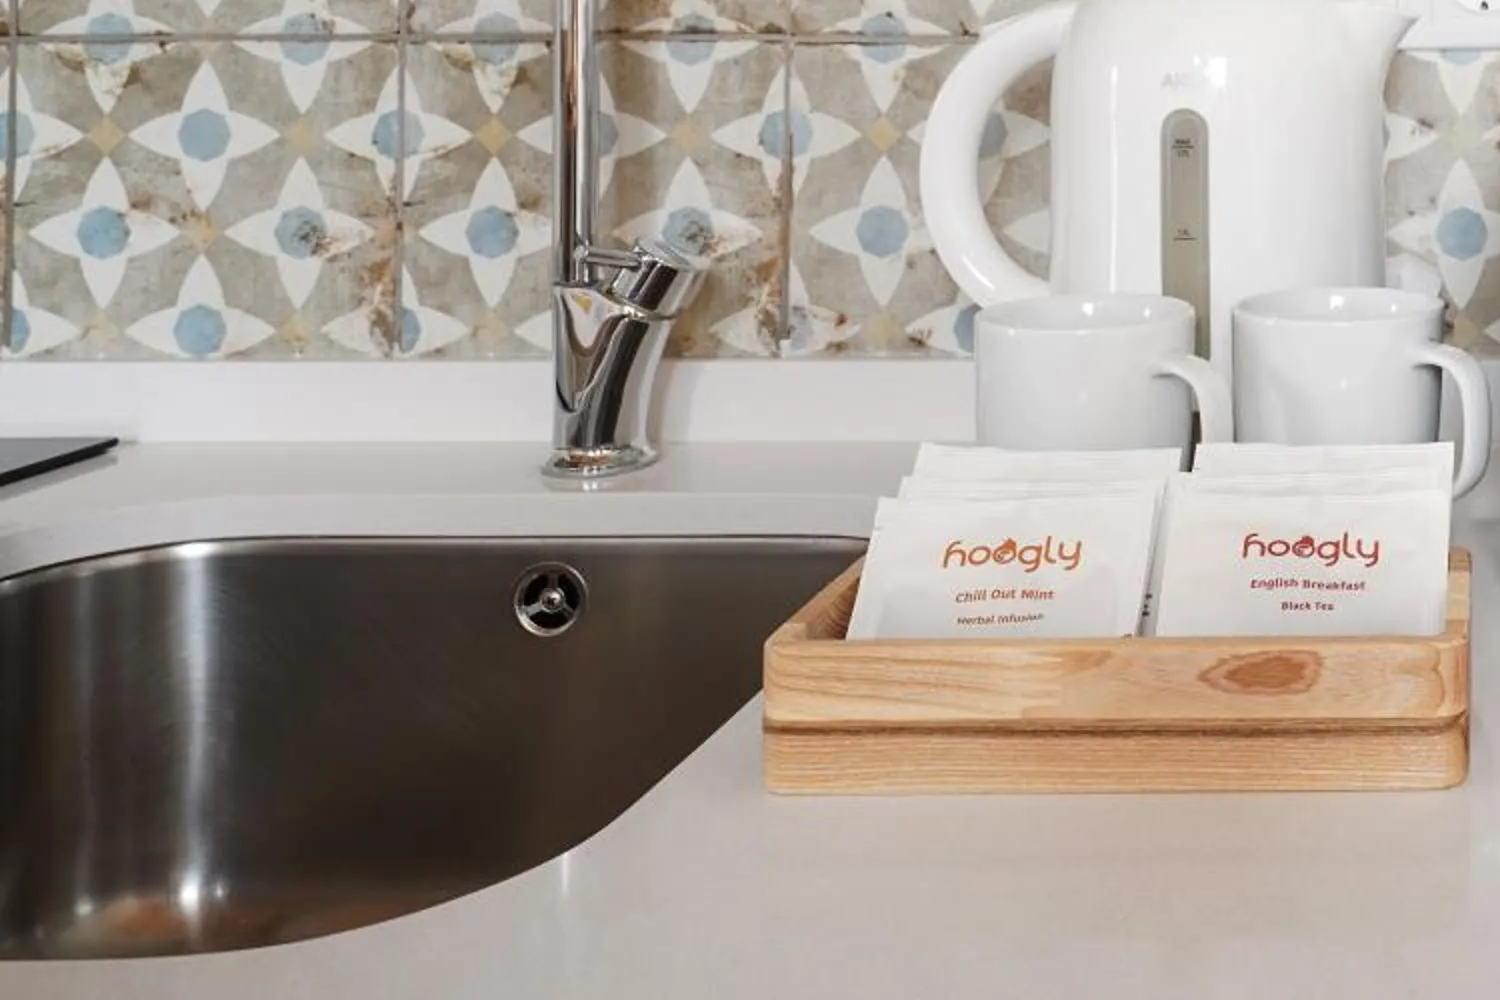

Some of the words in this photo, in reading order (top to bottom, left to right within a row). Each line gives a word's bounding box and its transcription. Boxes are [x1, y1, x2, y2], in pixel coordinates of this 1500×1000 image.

[942, 535, 1083, 574] hoogly
[1242, 531, 1380, 568] hoogly
[1250, 577, 1299, 591] English
[1302, 579, 1366, 592] Breakfast
[955, 589, 987, 604] Chill
[990, 588, 1017, 601] Out
[1020, 588, 1056, 602] Mint
[1281, 601, 1311, 612] Black
[1314, 601, 1335, 612] Tea
[957, 614, 995, 626] Herbal
